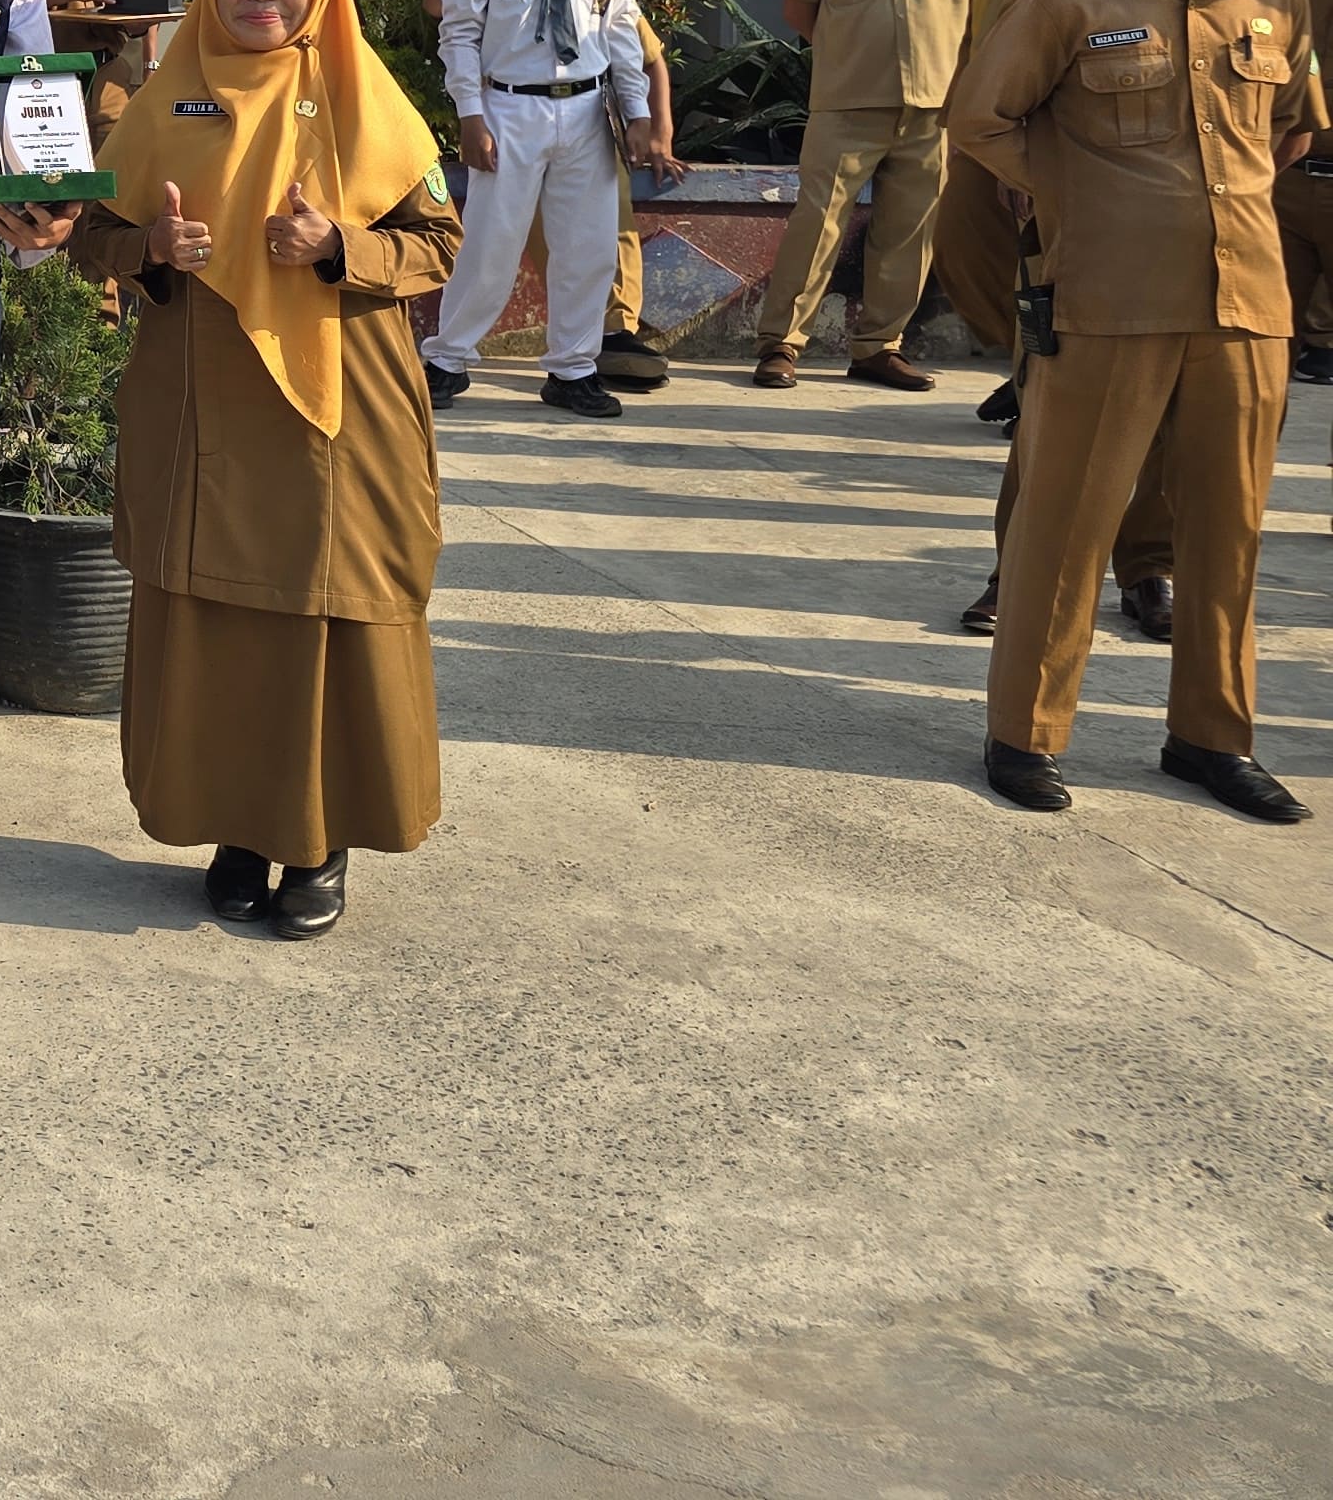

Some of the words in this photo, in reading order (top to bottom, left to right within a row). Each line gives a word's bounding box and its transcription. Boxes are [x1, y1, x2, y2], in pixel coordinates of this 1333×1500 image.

[21, 106, 55, 119] JUARA
[58, 105, 63, 118] 1
[182, 104, 206, 112] JULIA
